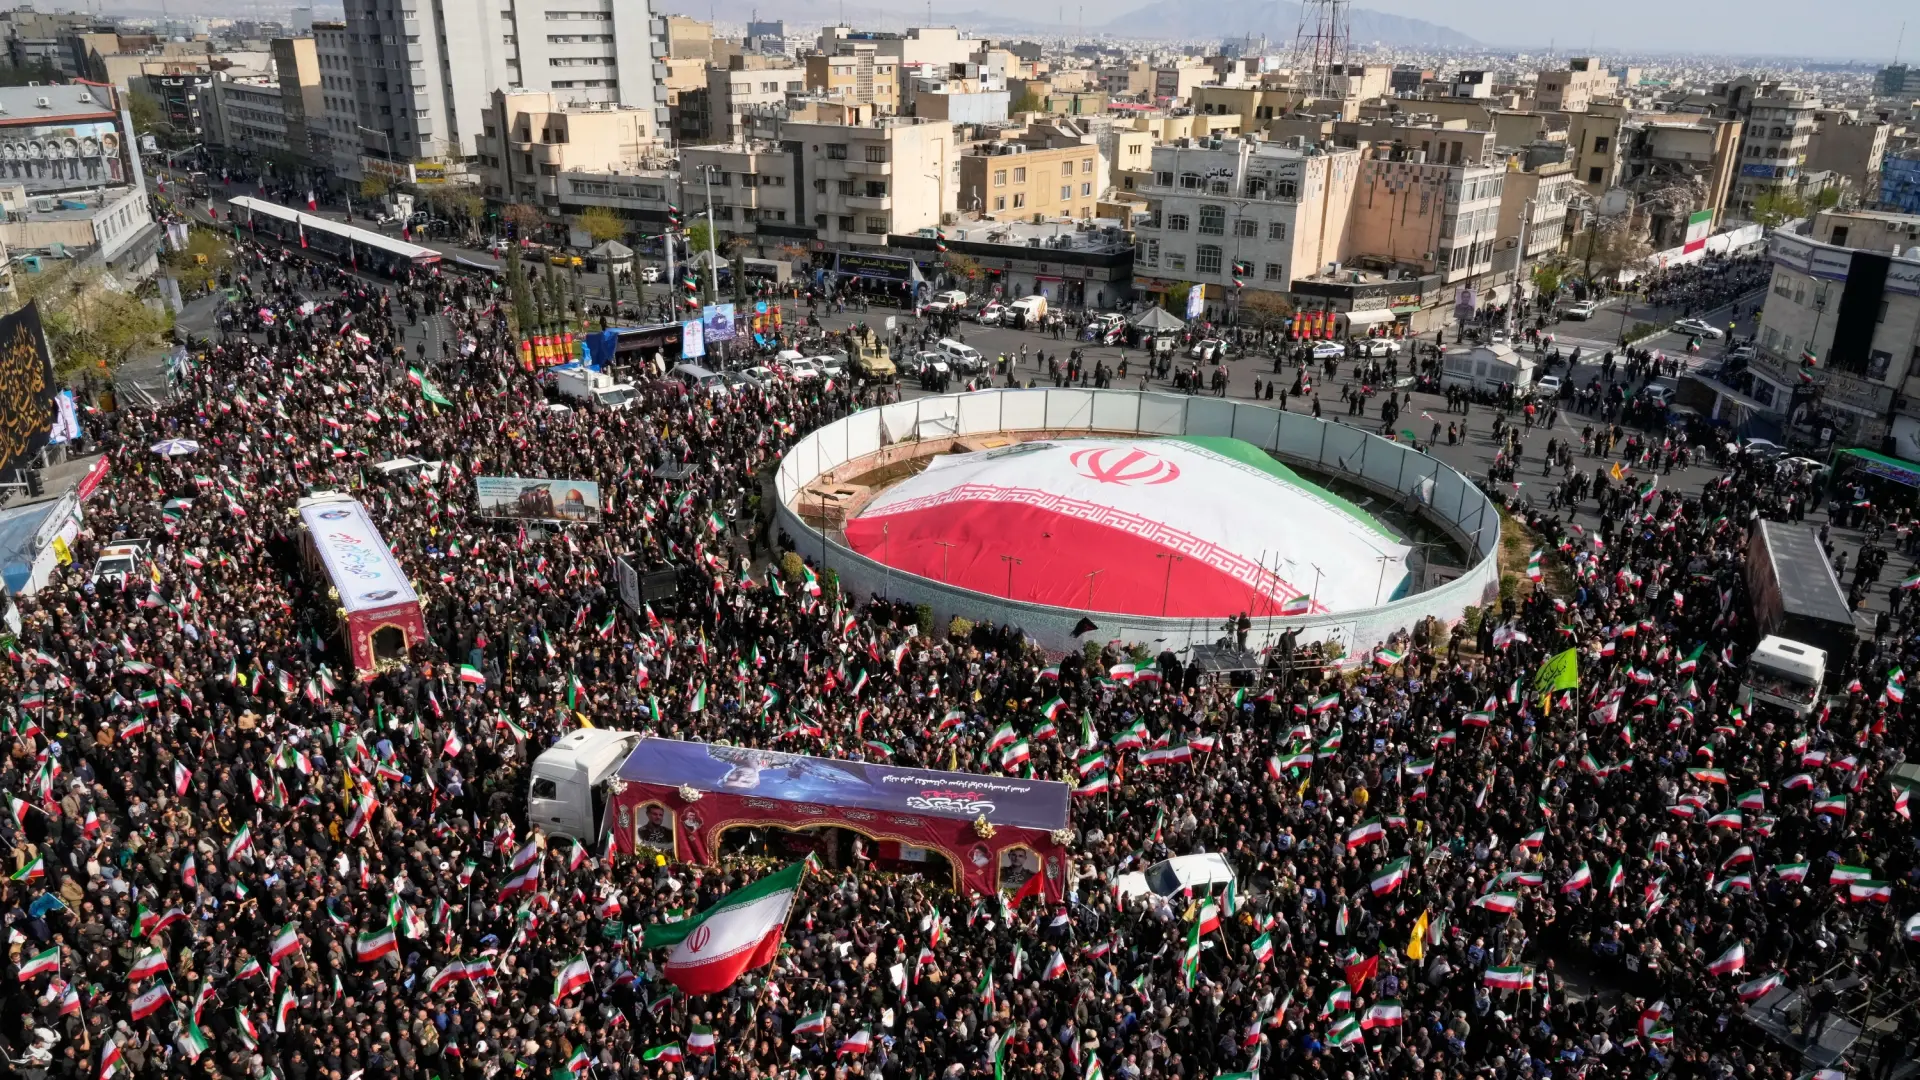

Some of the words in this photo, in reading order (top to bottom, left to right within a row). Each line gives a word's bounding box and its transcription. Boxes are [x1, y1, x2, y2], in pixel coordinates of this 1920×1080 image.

[882, 775, 899, 783] فرزند
[900, 775, 915, 784] دلیر
[948, 780, 968, 789] سرباز
[968, 781, 983, 789] ایران
[988, 782, 1011, 791] پاسدار
